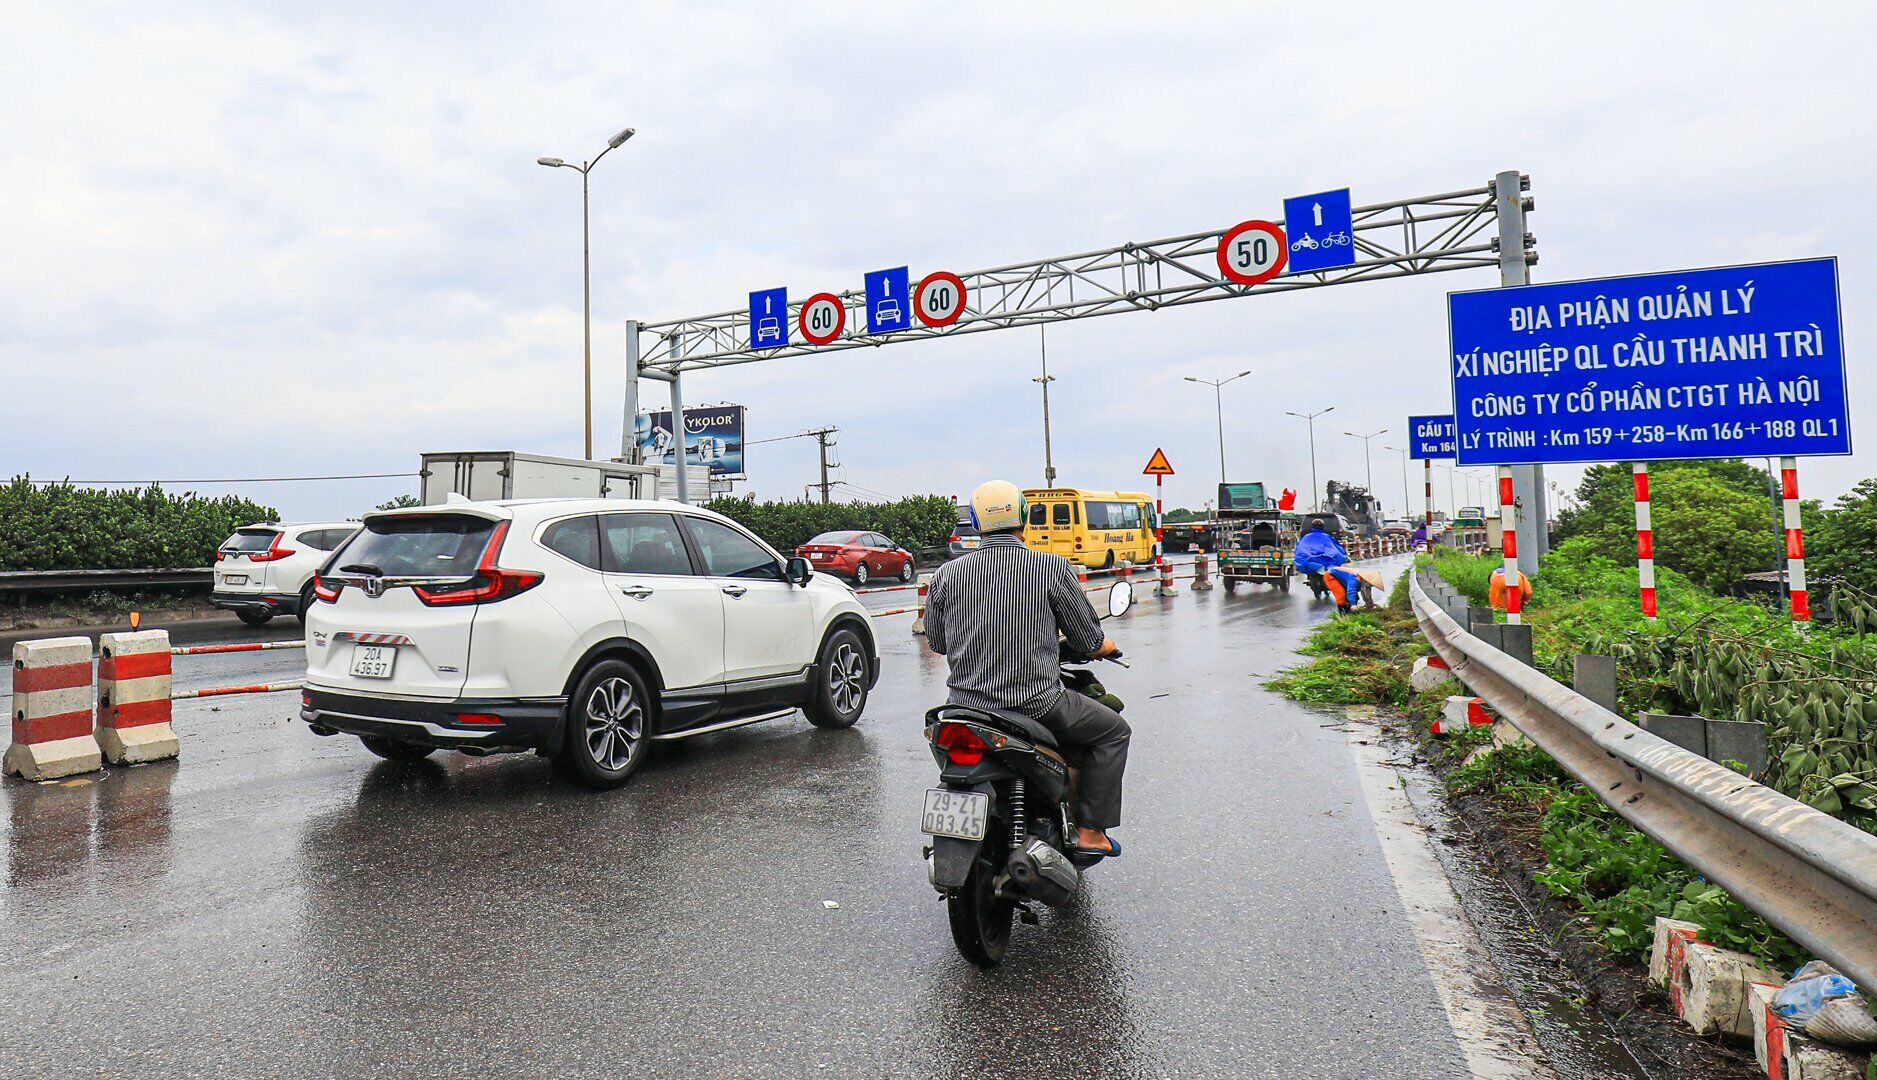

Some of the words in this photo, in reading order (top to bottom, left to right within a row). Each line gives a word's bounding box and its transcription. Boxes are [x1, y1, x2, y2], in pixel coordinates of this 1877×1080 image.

[1237, 238, 1267, 268] 50
[929, 287, 950, 312] 60
[1509, 305, 1552, 334] ĐỊA
[1559, 295, 1629, 329] PHẬN
[1638, 285, 1712, 321] QUẢN
[1721, 280, 1755, 315] LÝ
[811, 307, 831, 330] 60
[1483, 343, 1568, 377] NGHIỆP
[1574, 344, 1607, 369] QL
[1613, 333, 1665, 367] CẦU
[1671, 332, 1767, 364] THANH
[1774, 323, 1823, 358] TRÌ
[1471, 393, 1526, 418] CÔNG
[1533, 393, 1560, 414] TY
[1566, 381, 1597, 412] CỔ
[1601, 381, 1662, 412] PHẦN
[1667, 384, 1729, 408] CTGT
[1738, 376, 1773, 405] HÀ
[1779, 375, 1820, 406] NỘI
[1421, 442, 1438, 453] Km
[1462, 428, 1481, 450] LÝ
[1486, 427, 1536, 448] TRÌNH
[364, 647, 382, 660] 20A
[354, 661, 388, 676] 436.97
[924, 812, 982, 837] 083.45
